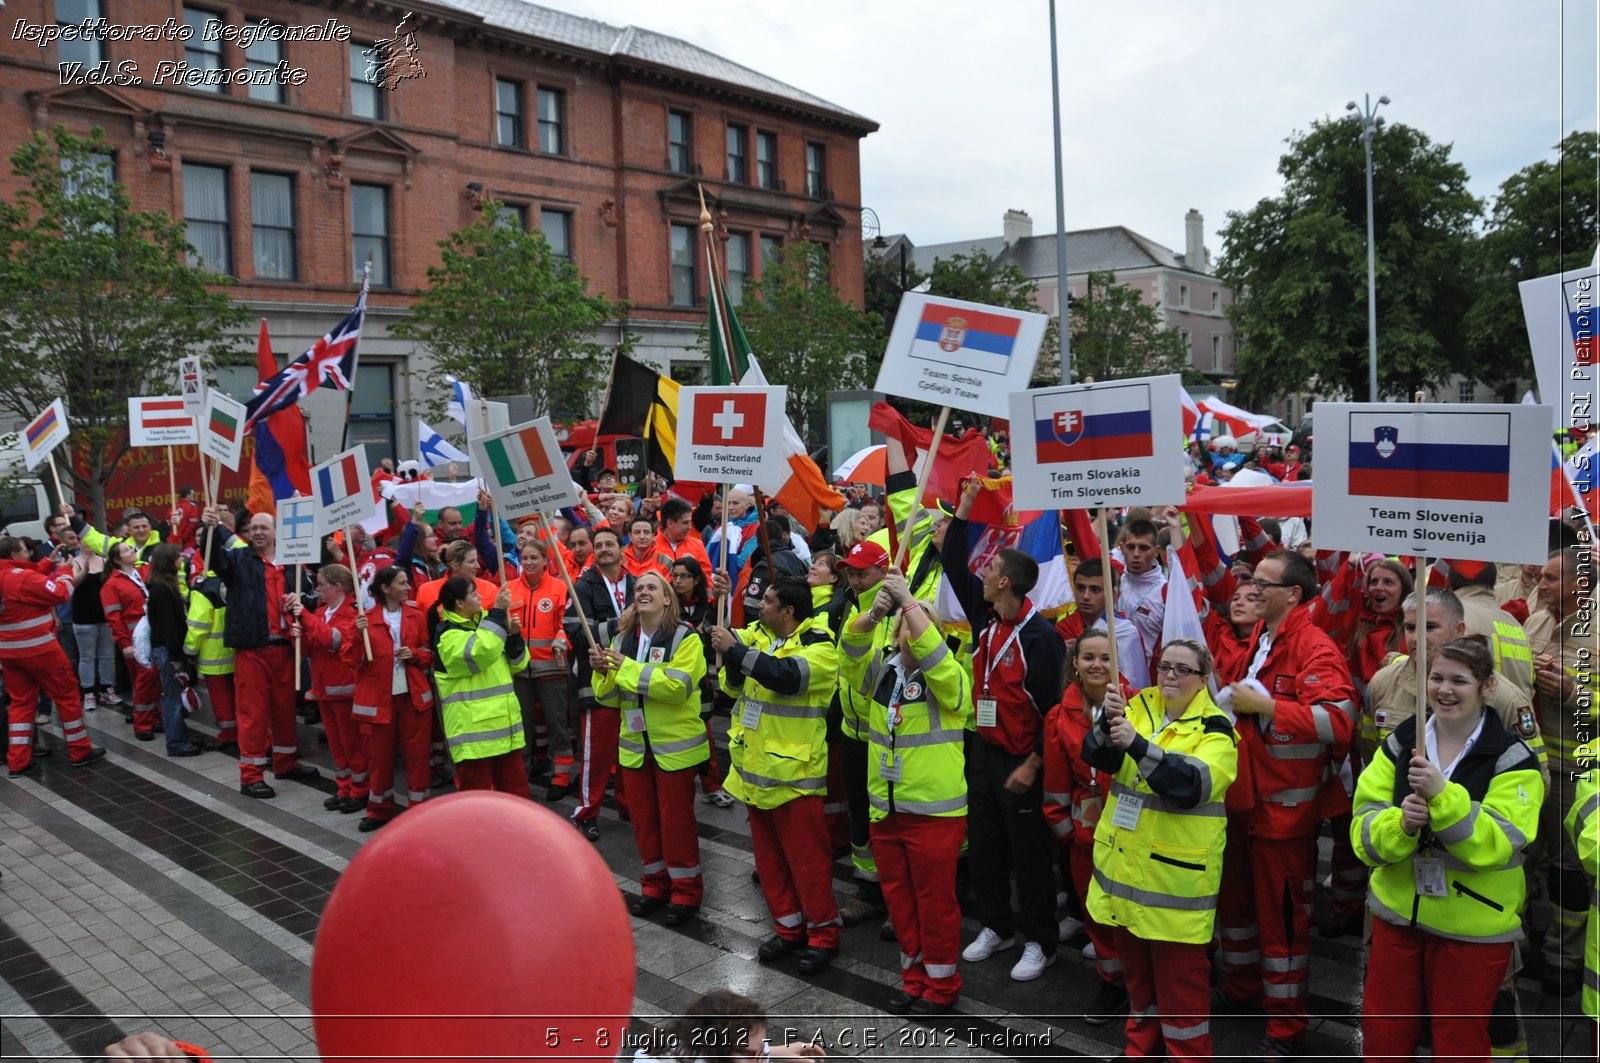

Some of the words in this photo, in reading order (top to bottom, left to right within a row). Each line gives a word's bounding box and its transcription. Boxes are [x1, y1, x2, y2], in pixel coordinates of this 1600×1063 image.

[923, 368, 949, 380] Team
[950, 373, 984, 387] Serbia
[692, 452, 713, 461] Team
[715, 453, 762, 463] Switzerland
[698, 465, 719, 474] Team
[721, 466, 753, 476] Schweiz
[1050, 471, 1083, 482] Team
[1087, 467, 1140, 480] Slovakia
[510, 489, 528, 498] Team
[527, 482, 551, 494] Ireland
[1077, 484, 1142, 498] Slovensko
[530, 498, 539, 506] na
[1369, 507, 1411, 520] Team
[1416, 509, 1484, 524] Slovenia
[1366, 525, 1408, 539] Team
[1412, 528, 1487, 545] Slovenija
